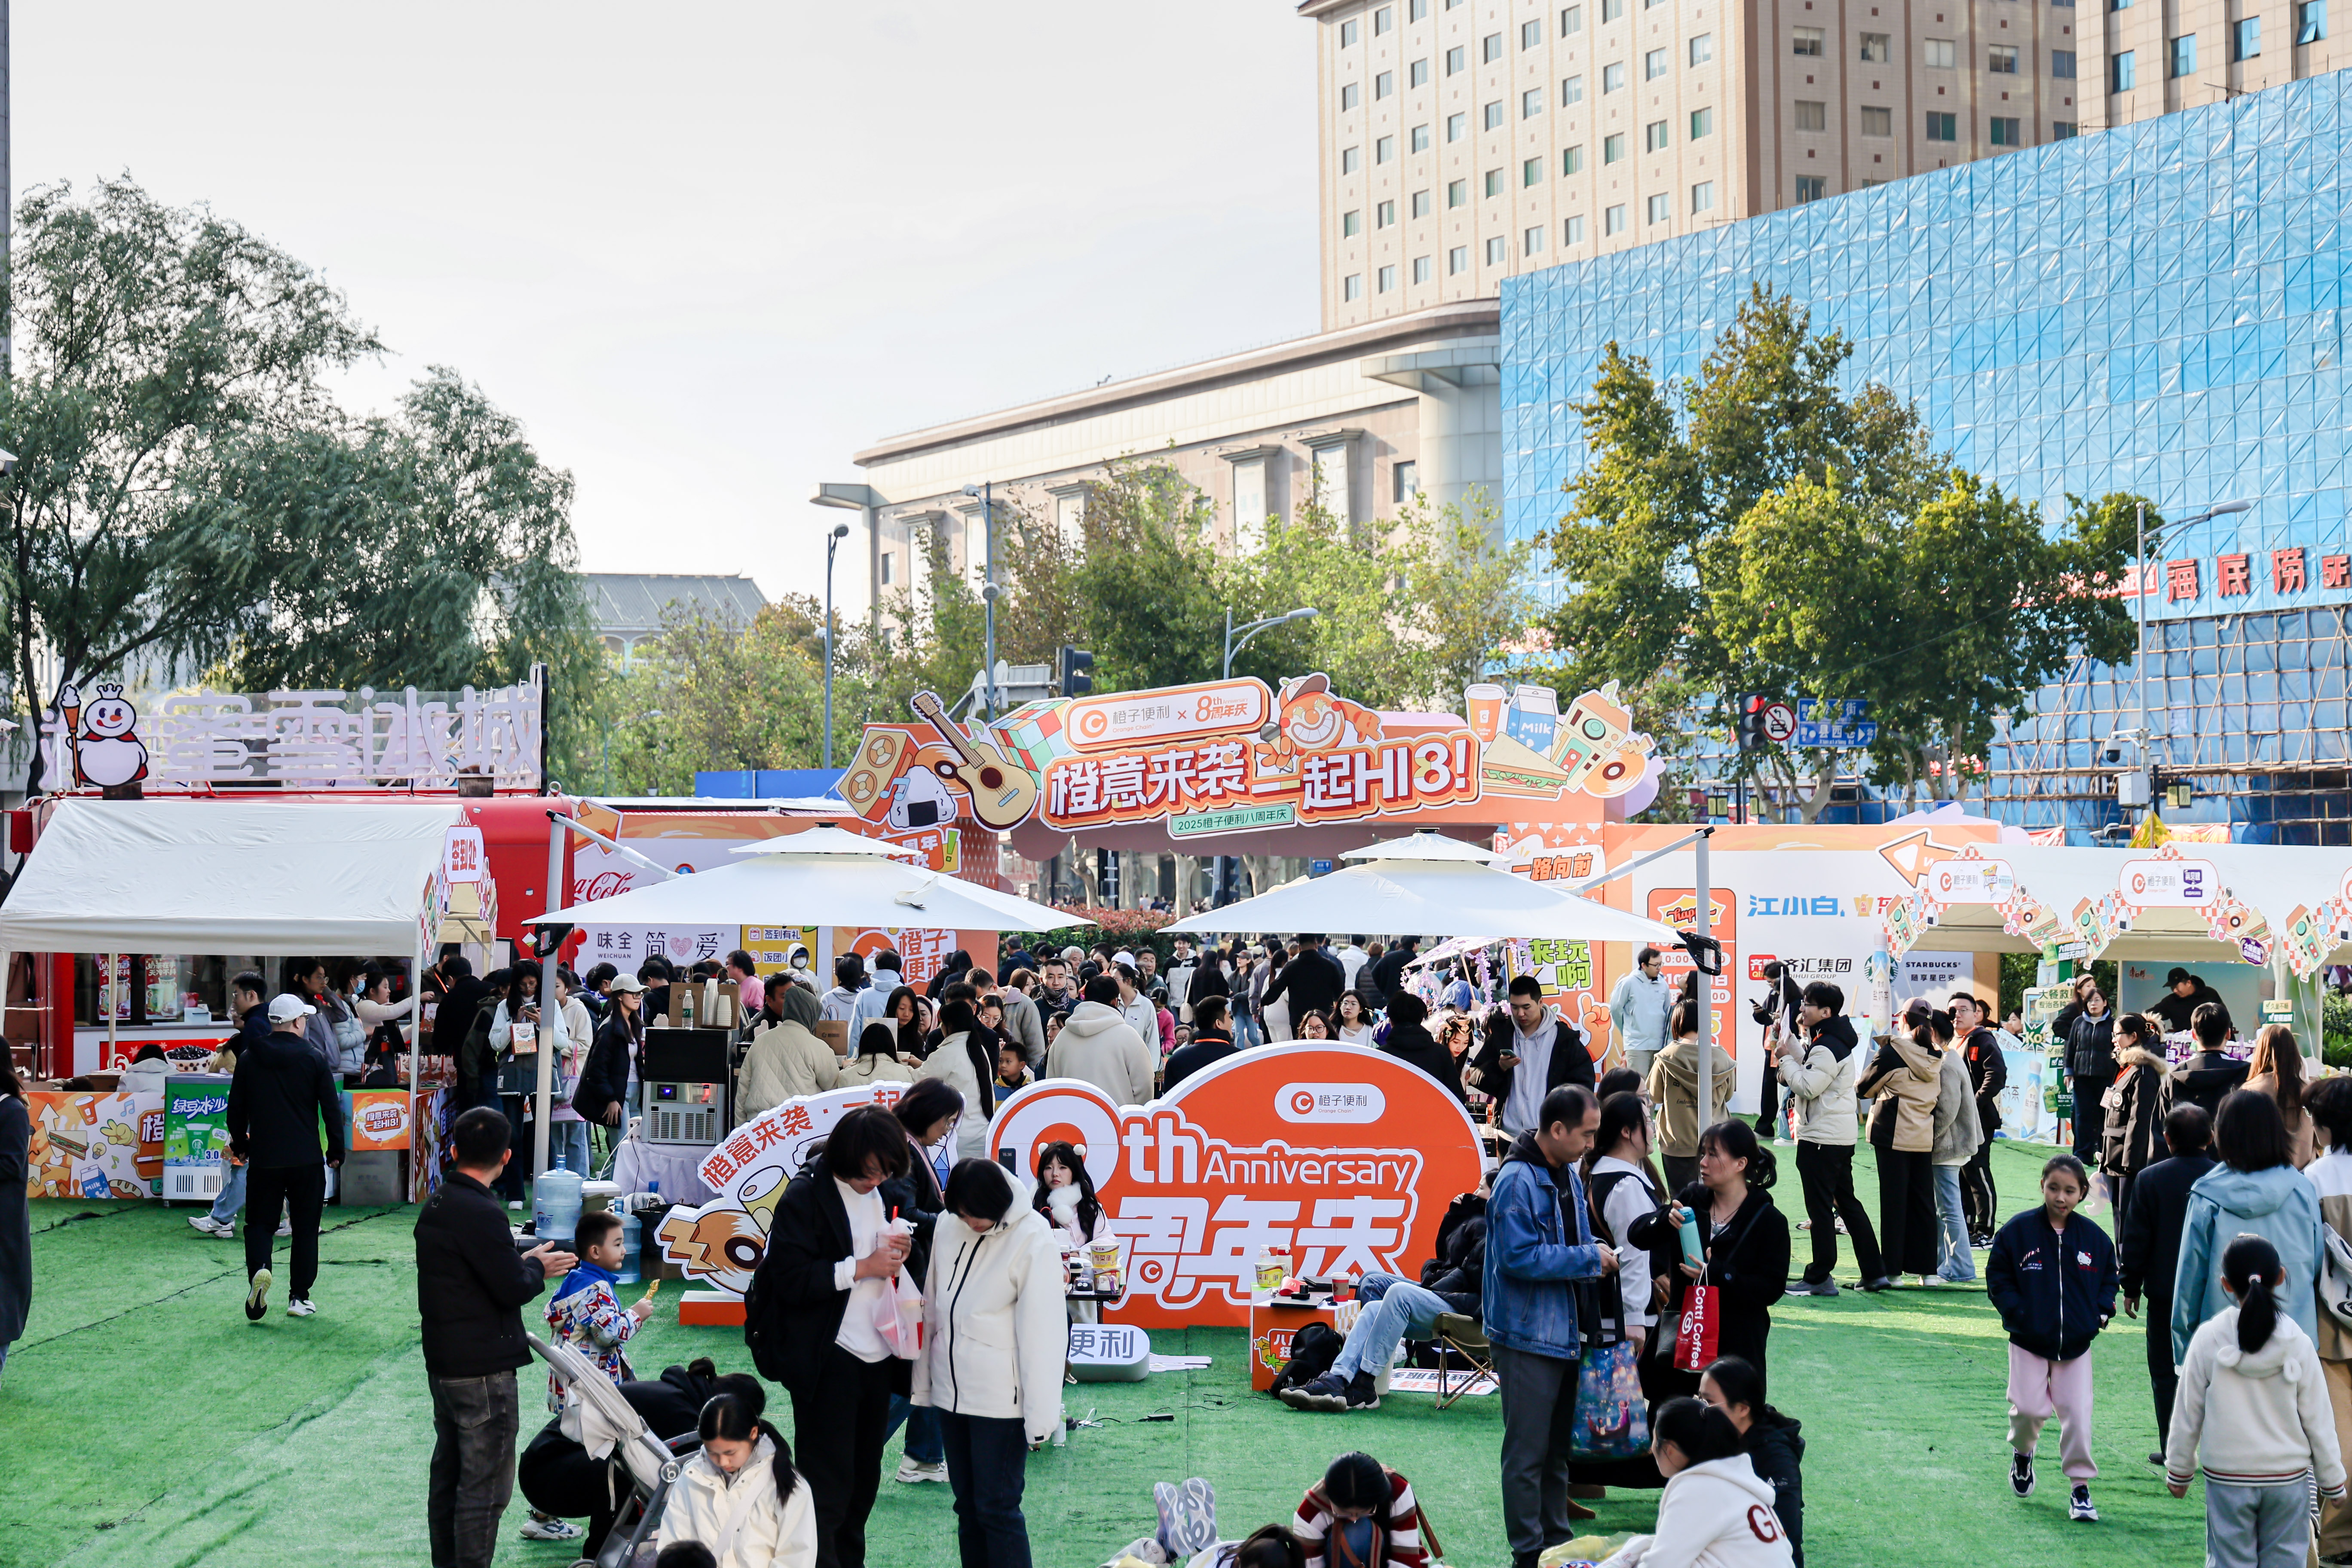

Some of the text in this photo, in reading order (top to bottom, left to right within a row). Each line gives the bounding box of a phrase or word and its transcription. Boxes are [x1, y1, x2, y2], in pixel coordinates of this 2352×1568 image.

[2166, 548, 2305, 603] 海底捞
[2322, 555, 2348, 586] 5F
[1112, 705, 1170, 725] 橙子便利
[1211, 703, 1248, 720] 周年庆
[163, 686, 541, 779] 蜜雪冰城
[1112, 725, 1134, 733] Orange
[1522, 723, 1552, 735] Milk
[1178, 809, 1286, 830] 2025橙子便利八周年庆
[451, 839, 477, 871] 签到处
[1511, 852, 1593, 881] 一路向前
[574, 871, 636, 901] a-Cola
[1954, 875, 1978, 885] 橙子便利
[2147, 876, 2176, 886] 橙子便利
[1747, 895, 1839, 917] 江小白
[597, 932, 632, 949] 味全
[763, 929, 800, 940] 签到有礼
[899, 928, 948, 955] 橙子
[101, 969, 130, 977] 天不抖
[148, 968, 177, 976] 天冷不抖
[1556, 962, 1590, 988] 啊
[1784, 959, 1852, 973] 齐汇集团
[2025, 1032, 2046, 1044] Ko!
[172, 1096, 228, 1119] 绿豆冰沙
[1318, 1095, 1367, 1107] 橙子便利
[366, 1109, 398, 1121] 橙意来袭
[205, 1151, 219, 1159] 3.0
[1203, 1151, 1412, 1191] Anniversary
[85, 1183, 101, 1192] Milk
[1108, 1194, 1406, 1295] 周年庆
[1694, 1286, 1706, 1320] Cotti
[1690, 1323, 1704, 1368] Coffee
